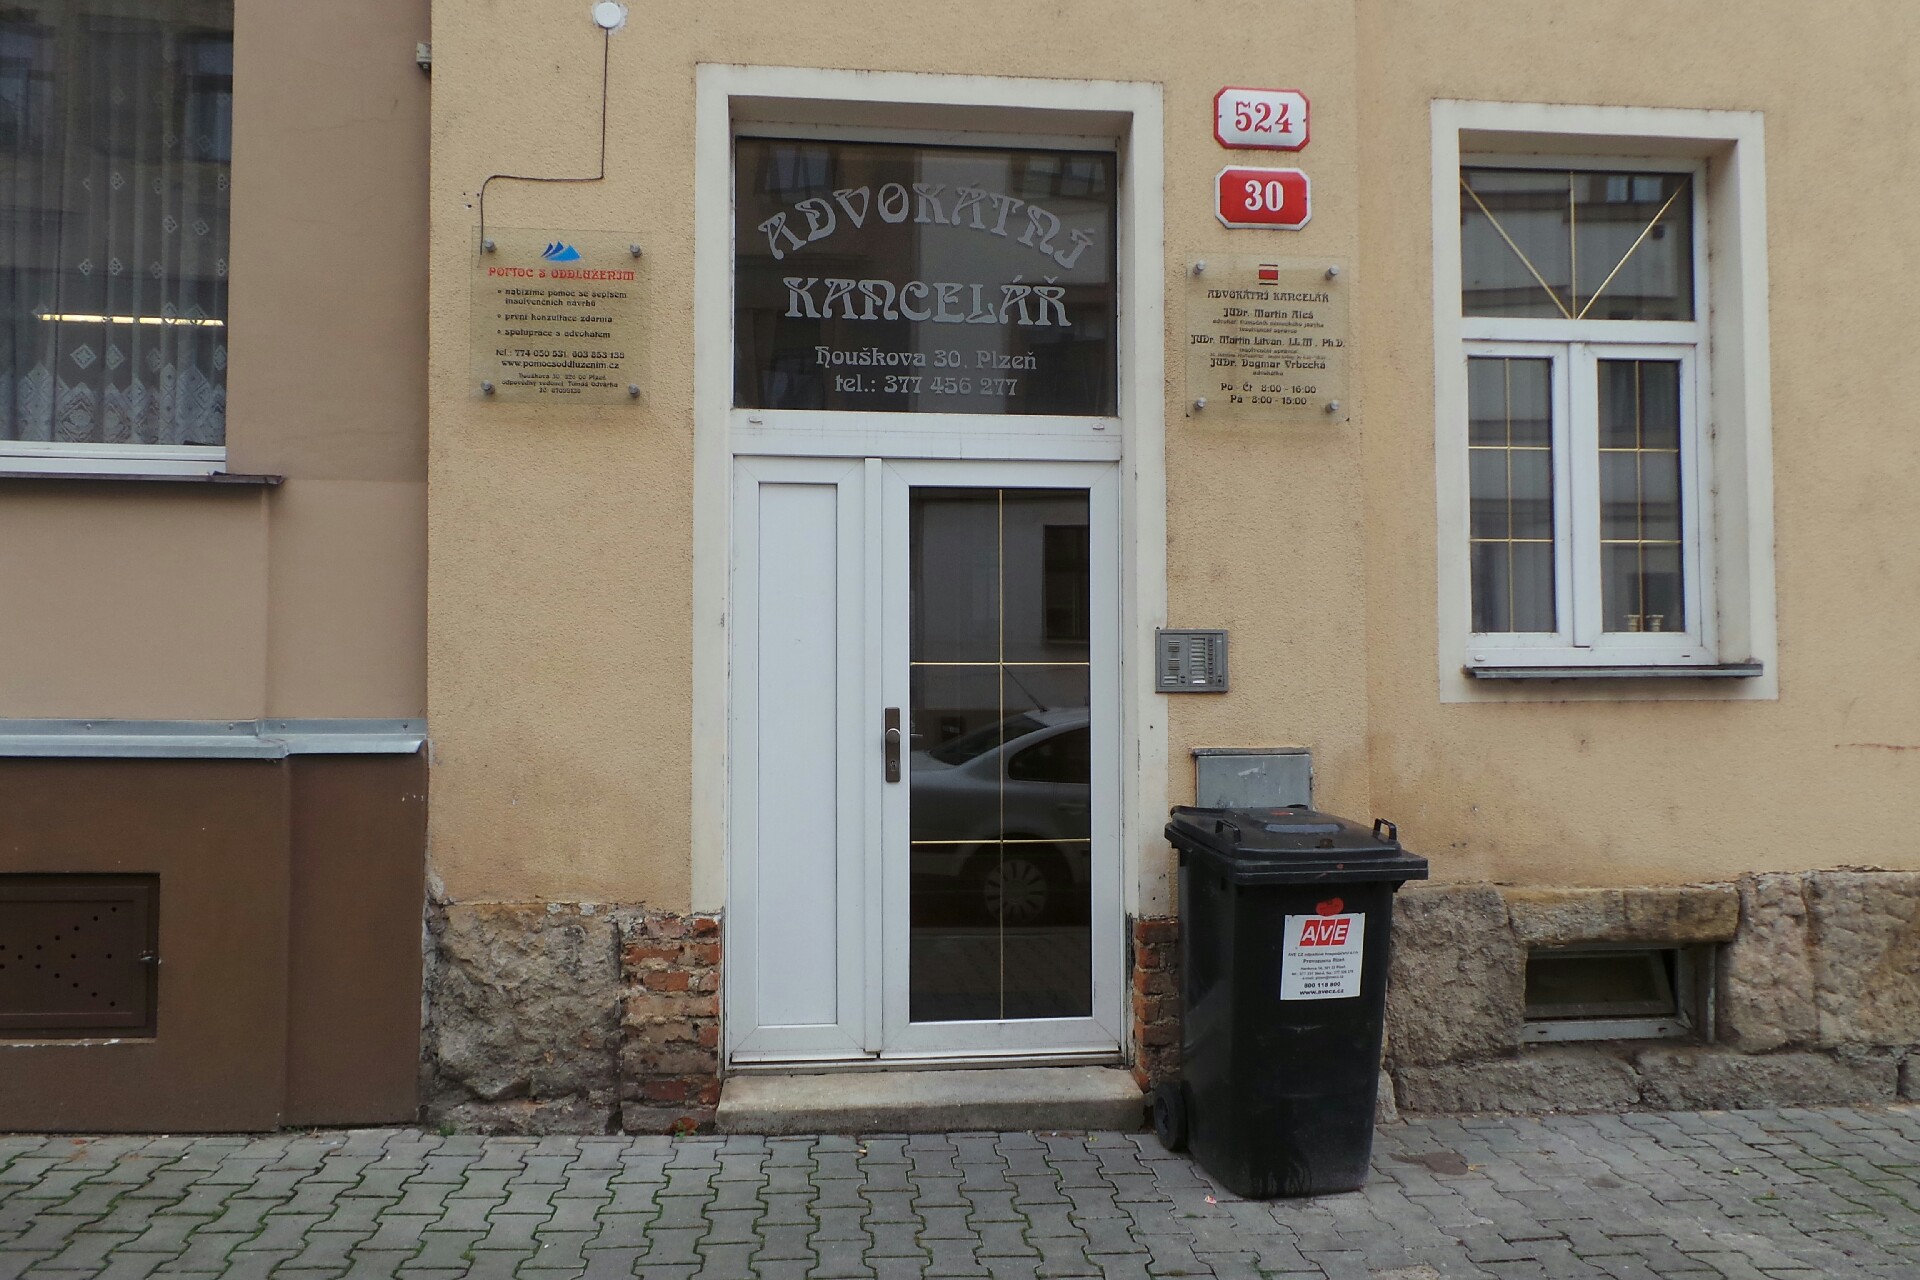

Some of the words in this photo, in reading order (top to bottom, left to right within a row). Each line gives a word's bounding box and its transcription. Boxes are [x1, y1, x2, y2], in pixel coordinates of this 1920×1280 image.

[1235, 101, 1293, 134] 524
[1245, 180, 1284, 212] 30
[539, 269, 546, 279] S
[548, 290, 577, 298] pomoc
[1208, 288, 1269, 301] ADVOKÁTNÍ
[1273, 291, 1329, 303] KANCELÁŘ
[783, 275, 1072, 327] KANCELÁŘ
[531, 314, 577, 322] konzultace
[580, 315, 613, 323] zdarma
[1223, 308, 1250, 318] JUDr.
[1255, 309, 1287, 319] Martin
[1191, 335, 1216, 345] JUDr.
[1220, 335, 1250, 345] Martin
[1322, 338, 1346, 348] Ph.D.
[501, 359, 620, 369] www.pomocsoddluzenim.cz
[815, 346, 926, 369] Houškova
[976, 351, 1038, 370] Plzeň
[1210, 358, 1237, 368] JUDr.
[1242, 359, 1281, 369] Dagmar
[1285, 360, 1326, 370] Vrbecká
[835, 374, 876, 393] tel.:
[884, 375, 923, 394] 377
[930, 377, 972, 394] 456
[980, 378, 1018, 396] 277
[1221, 383, 1233, 391] Po
[1243, 382, 1252, 392] Čt
[1261, 384, 1282, 393] 8:00
[1292, 385, 1317, 394] 16:00
[1252, 396, 1272, 404] 8:00
[1283, 397, 1307, 405] 15:00
[1302, 925, 1348, 941] AVE
